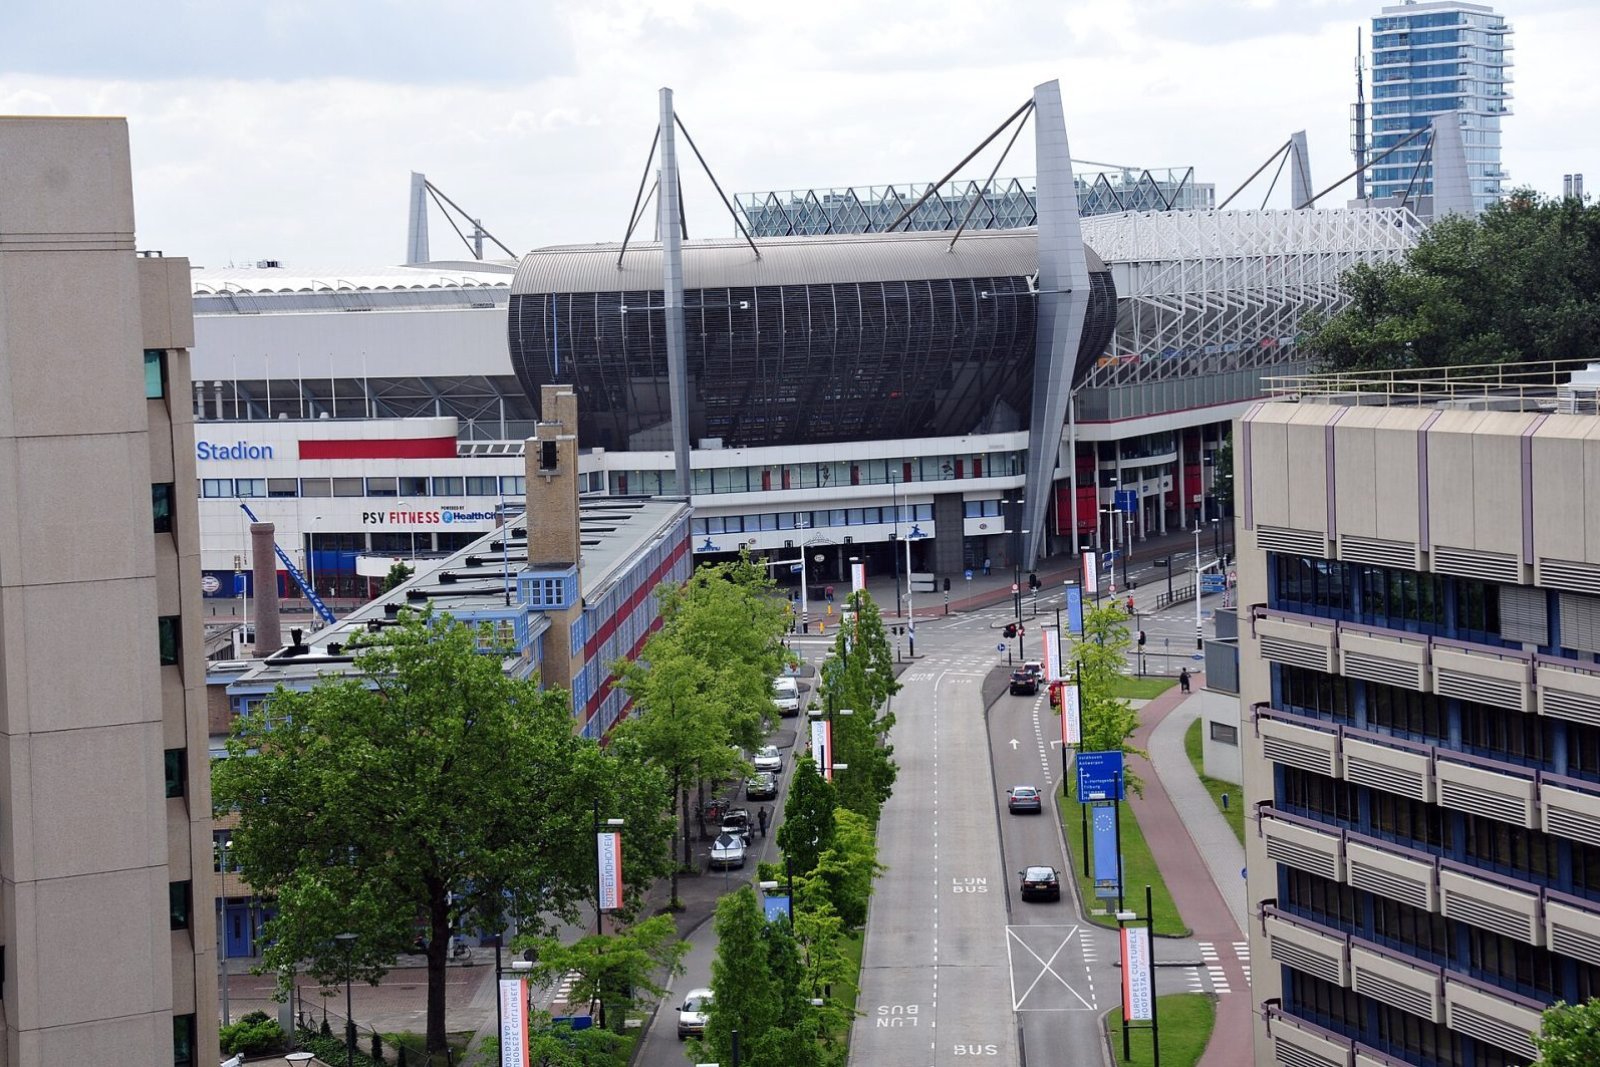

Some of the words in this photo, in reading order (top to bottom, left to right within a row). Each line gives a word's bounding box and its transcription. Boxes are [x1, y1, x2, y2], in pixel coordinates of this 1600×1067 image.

[197, 440, 273, 460] Stadion
[362, 511, 385, 525] PSV
[389, 511, 440, 525] FITNESS
[454, 512, 497, 520] HealthCit
[953, 886, 988, 894] BUS
[1129, 929, 1138, 975] CULTURELE
[1132, 977, 1141, 1019] EUROPESE
[1139, 971, 1149, 1019] HOOFDSTAD
[877, 1004, 919, 1015] BUS
[954, 1044, 998, 1056] BUS
